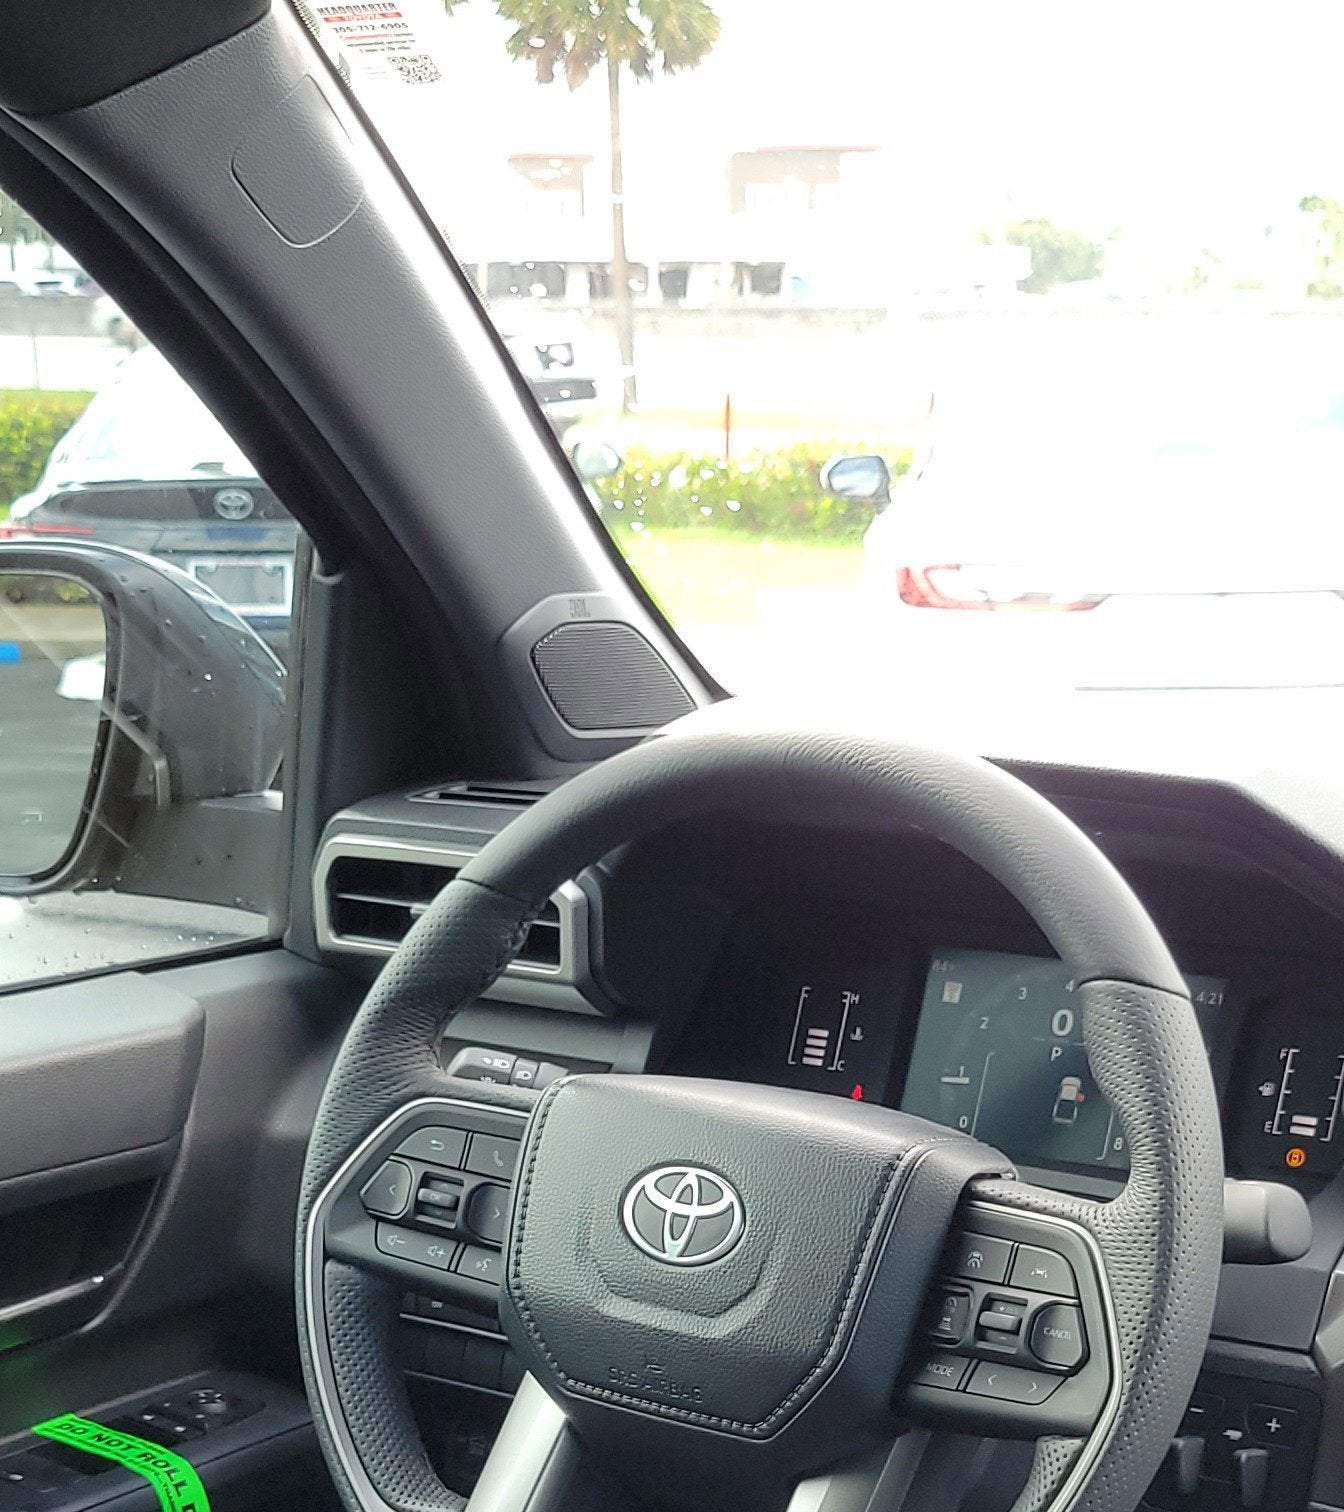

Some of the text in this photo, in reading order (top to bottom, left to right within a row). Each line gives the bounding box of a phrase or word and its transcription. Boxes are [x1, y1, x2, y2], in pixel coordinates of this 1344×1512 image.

[850, 993, 860, 1005] H
[1018, 987, 1028, 1000] 3
[979, 1016, 990, 1030] 2
[1051, 1009, 1075, 1037] 0
[1050, 1046, 1063, 1062] P
[1279, 1047, 1289, 1061] F
[836, 1060, 846, 1072] C
[959, 1115, 969, 1129] 0
[1263, 1120, 1274, 1134] E
[1113, 1137, 1124, 1151] 8
[1043, 1326, 1072, 1341] CANCEL
[924, 1361, 954, 1378] MODE
[56, 1421, 88, 1436] DO
[90, 1431, 139, 1453] NOT
[137, 1451, 188, 1498] ROLL
